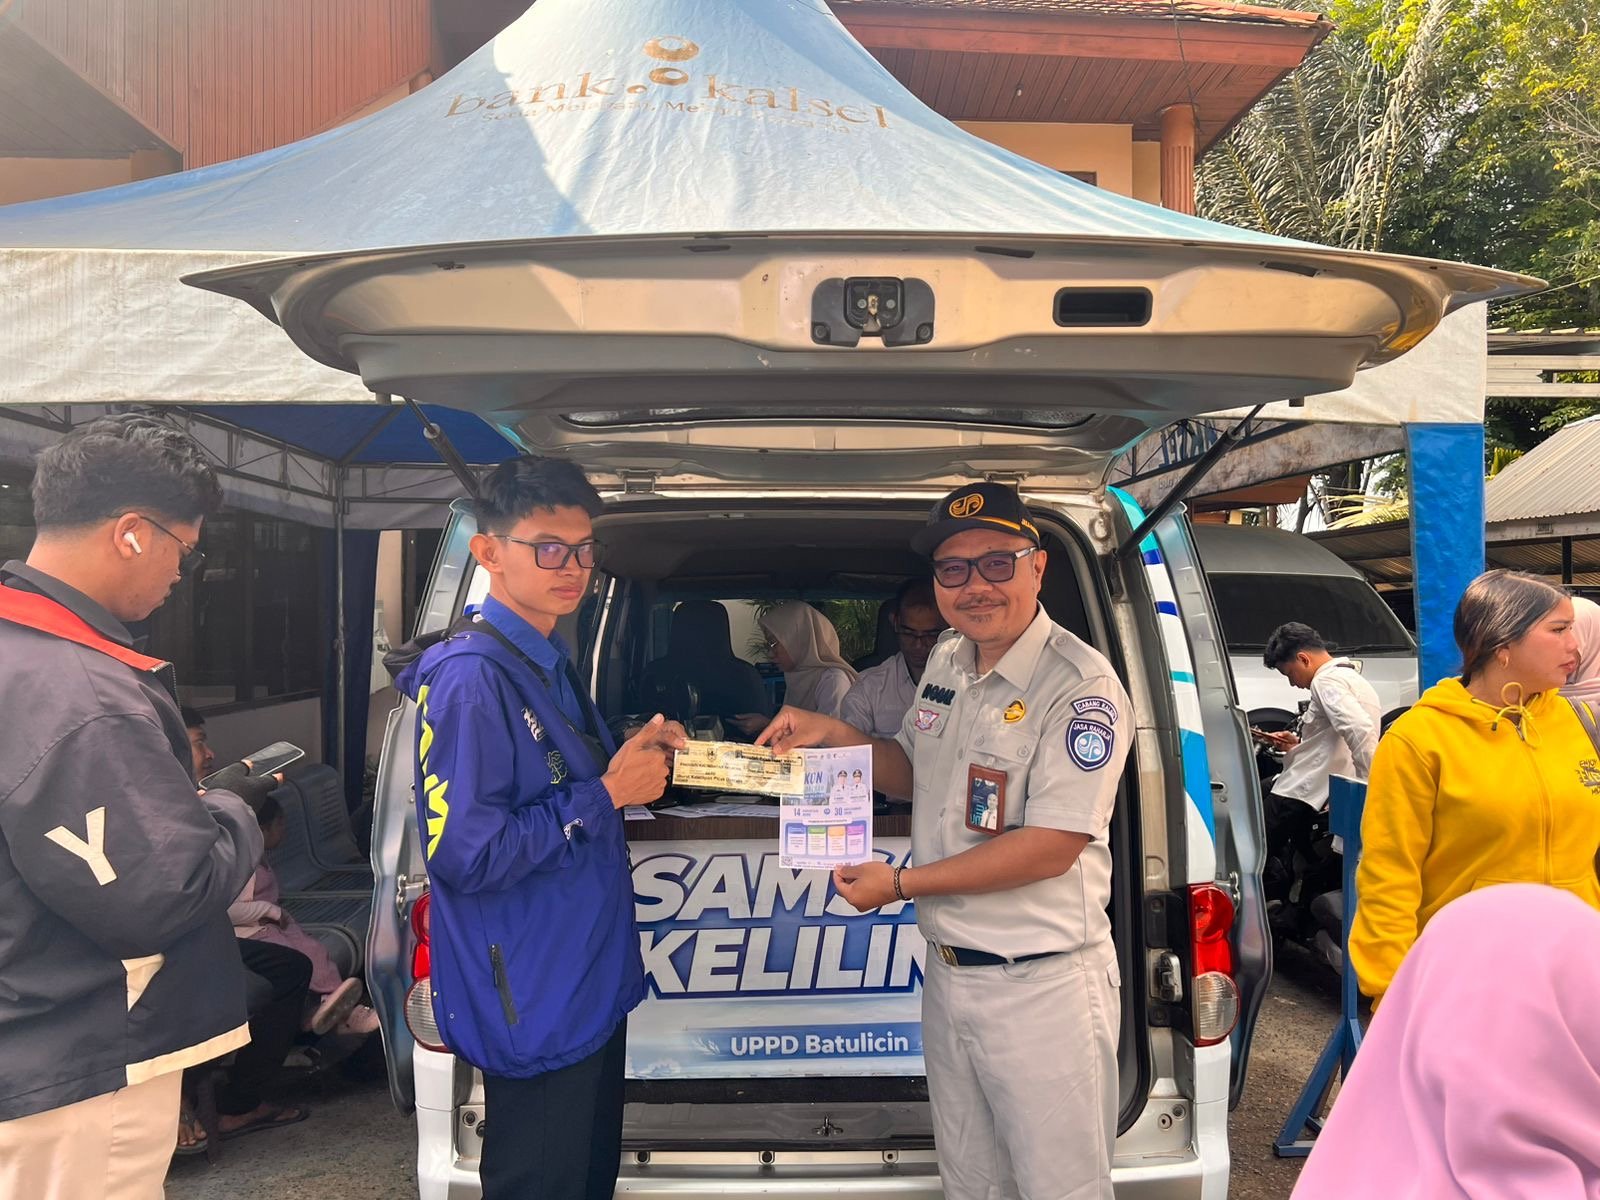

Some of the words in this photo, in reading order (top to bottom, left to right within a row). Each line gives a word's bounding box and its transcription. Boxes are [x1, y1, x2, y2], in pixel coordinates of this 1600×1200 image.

[445, 72, 615, 118] bank
[701, 74, 892, 129] kalsel
[1077, 700, 1100, 710] CABANG
[1073, 722, 1088, 731] JASA
[1089, 725, 1111, 741] RAHARJA
[631, 853, 914, 922] SAM
[730, 1035, 799, 1057] UPPD
[805, 1031, 909, 1055] Batulicin
